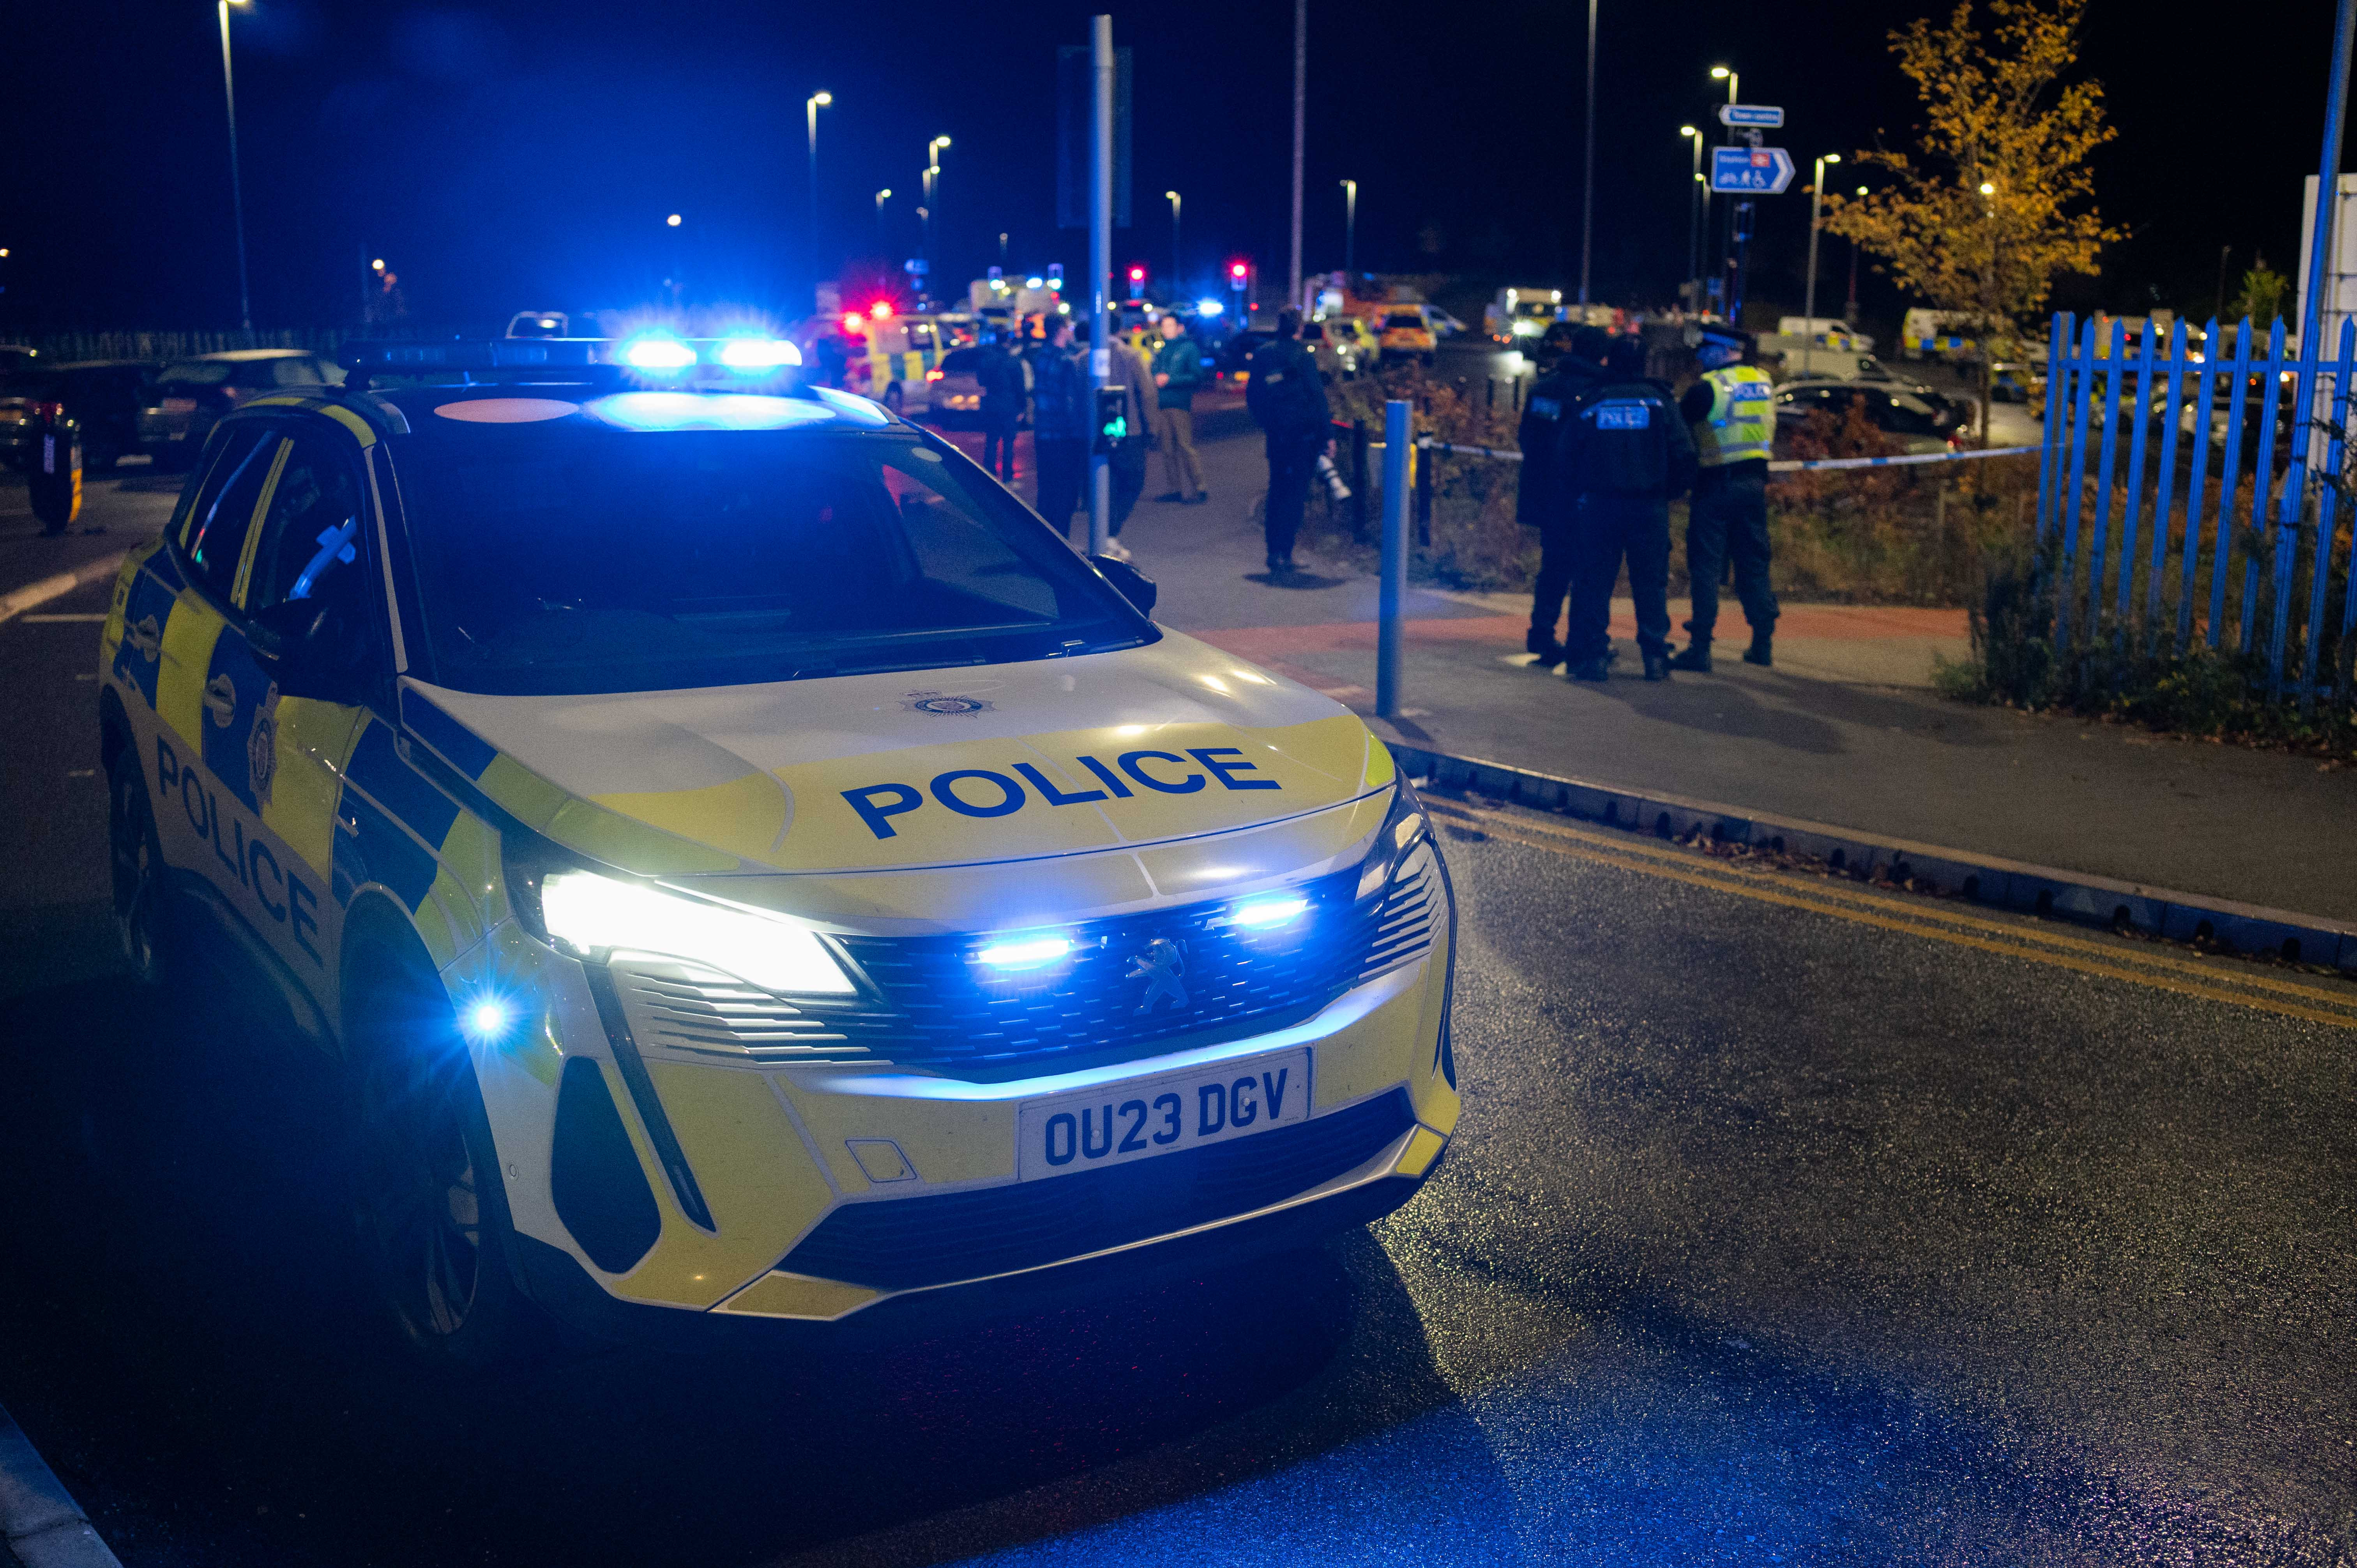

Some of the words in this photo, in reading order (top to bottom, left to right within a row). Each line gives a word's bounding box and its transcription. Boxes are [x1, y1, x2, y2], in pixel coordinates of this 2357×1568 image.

[840, 748, 1282, 839] POLICE
[157, 735, 323, 968] POLICE
[1045, 1092, 1182, 1166] OU23
[1198, 1068, 1288, 1137] DGV
